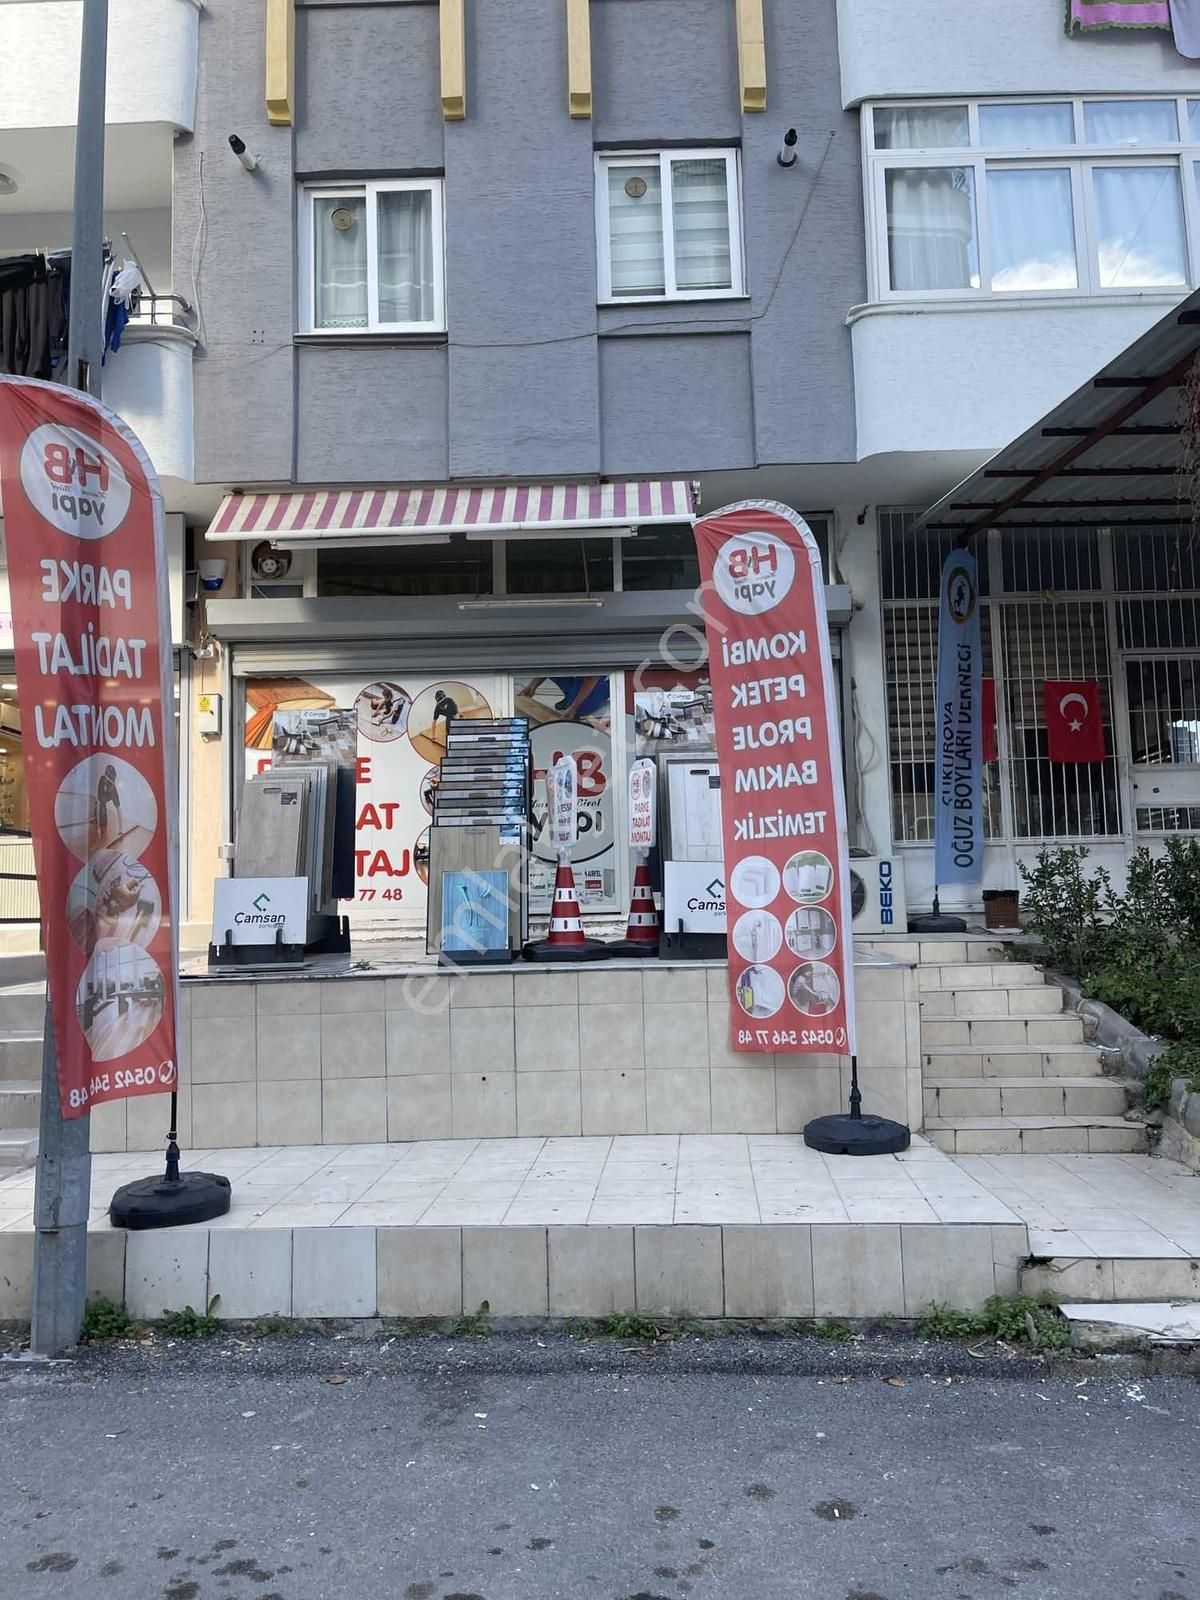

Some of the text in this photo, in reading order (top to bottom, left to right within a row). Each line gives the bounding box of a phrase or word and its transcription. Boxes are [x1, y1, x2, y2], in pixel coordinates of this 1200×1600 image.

[953, 728, 973, 811] BOYLARI
[530, 810, 603, 841] ypı
[950, 816, 974, 868] OĞUZ
[358, 889, 377, 901] 77
[381, 888, 404, 901] 48
[687, 898, 727, 913] Çams
[879, 861, 894, 925] BEKO
[234, 912, 286, 926] Çamsan
